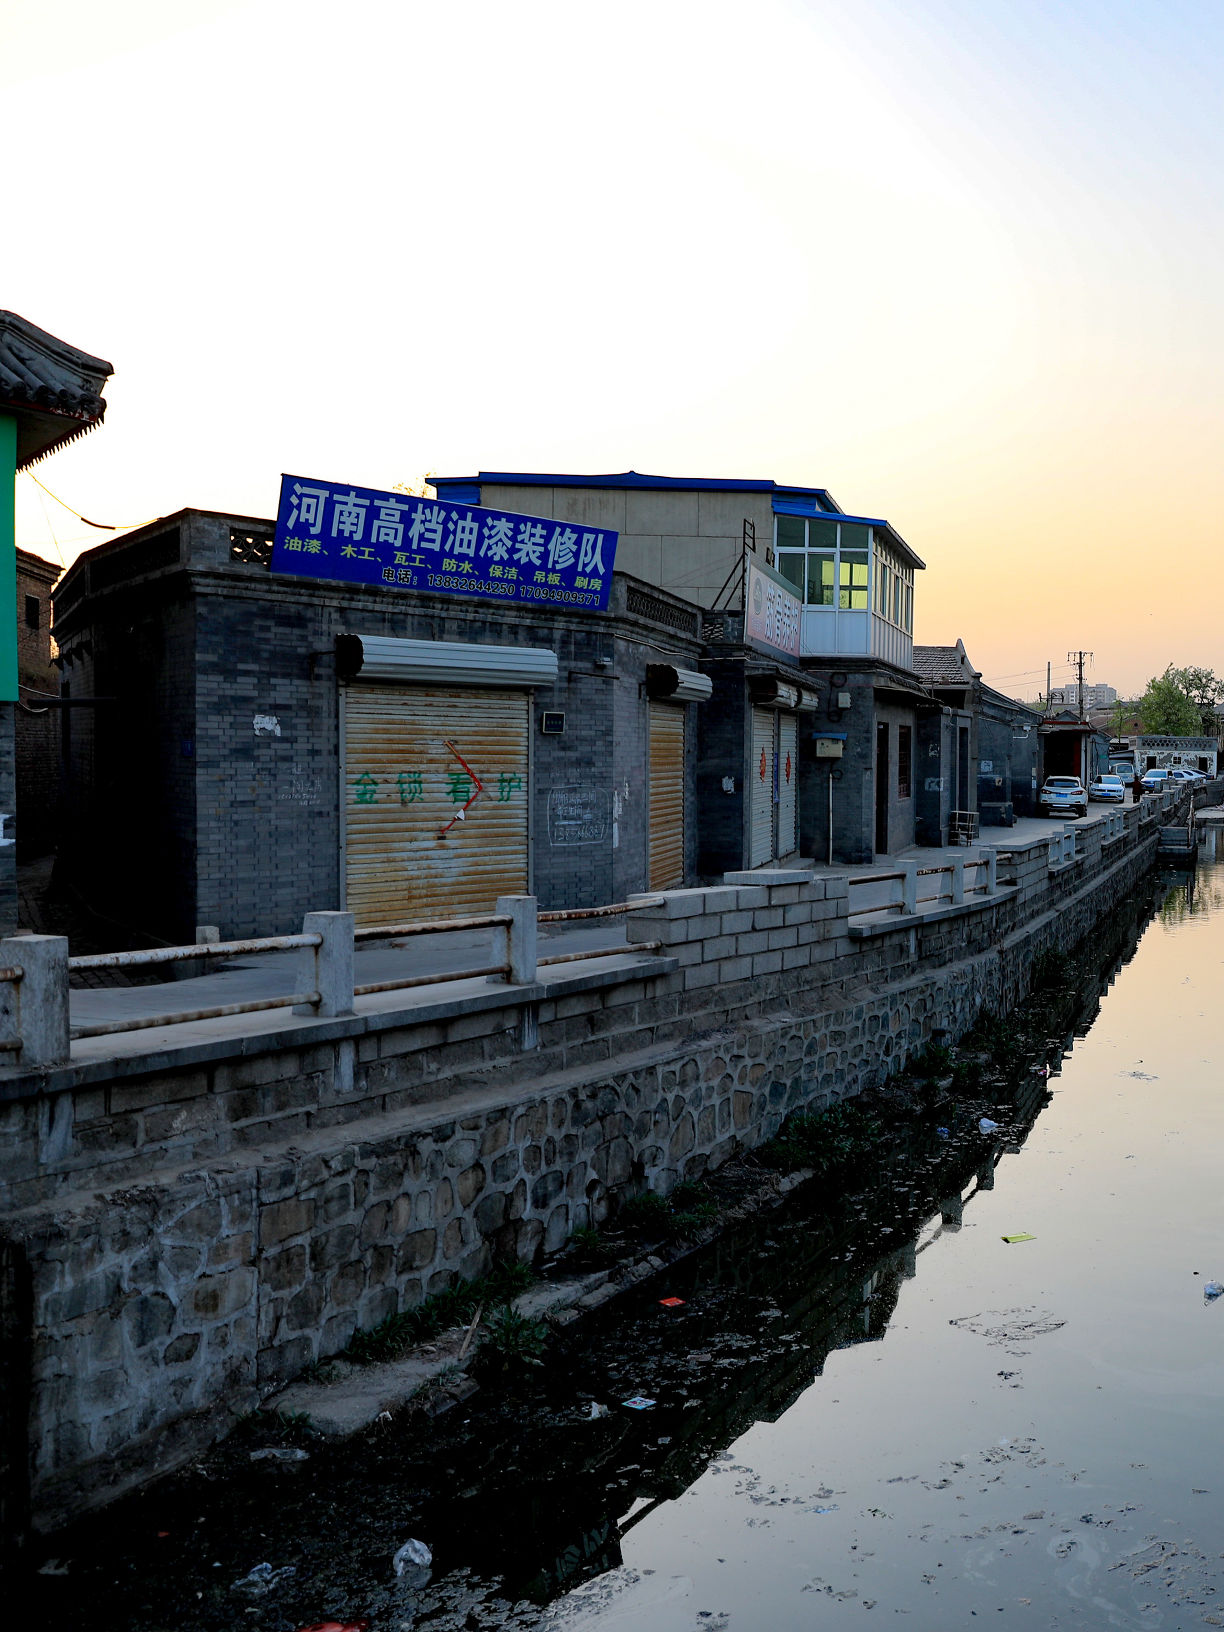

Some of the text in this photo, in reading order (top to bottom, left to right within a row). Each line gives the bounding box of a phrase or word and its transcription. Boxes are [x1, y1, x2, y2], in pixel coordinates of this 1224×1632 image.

[286, 482, 606, 576] 河南高档油漆装修队
[428, 574, 516, 596] 13832644250
[352, 771, 522, 804] 金锁看护
